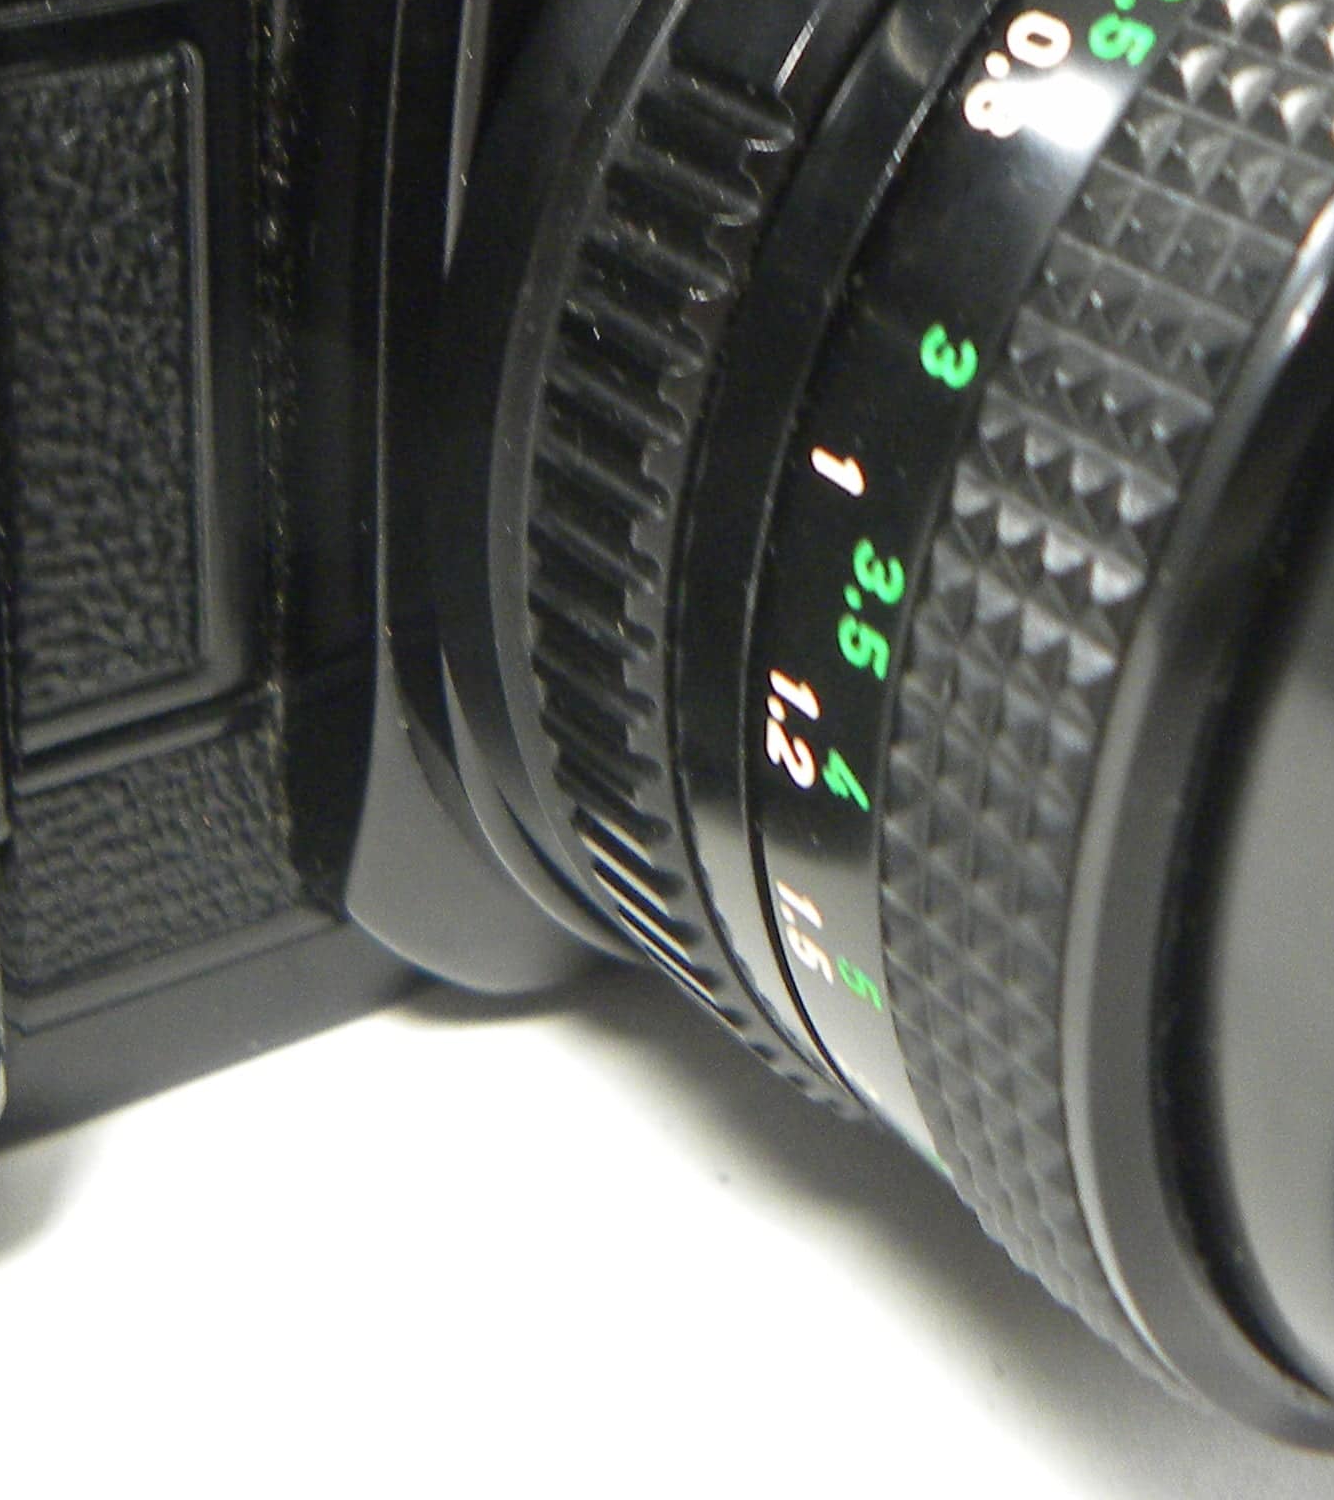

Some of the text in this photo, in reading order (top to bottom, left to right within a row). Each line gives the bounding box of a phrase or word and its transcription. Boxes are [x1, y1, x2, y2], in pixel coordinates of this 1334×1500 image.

[920, 322, 979, 391] 3
[810, 445, 867, 498] 1
[836, 537, 907, 682] 3.5
[764, 667, 822, 791] 1.2
[821, 747, 871, 813] 4
[774, 879, 835, 986] 1.5
[835, 955, 884, 1012] 5
